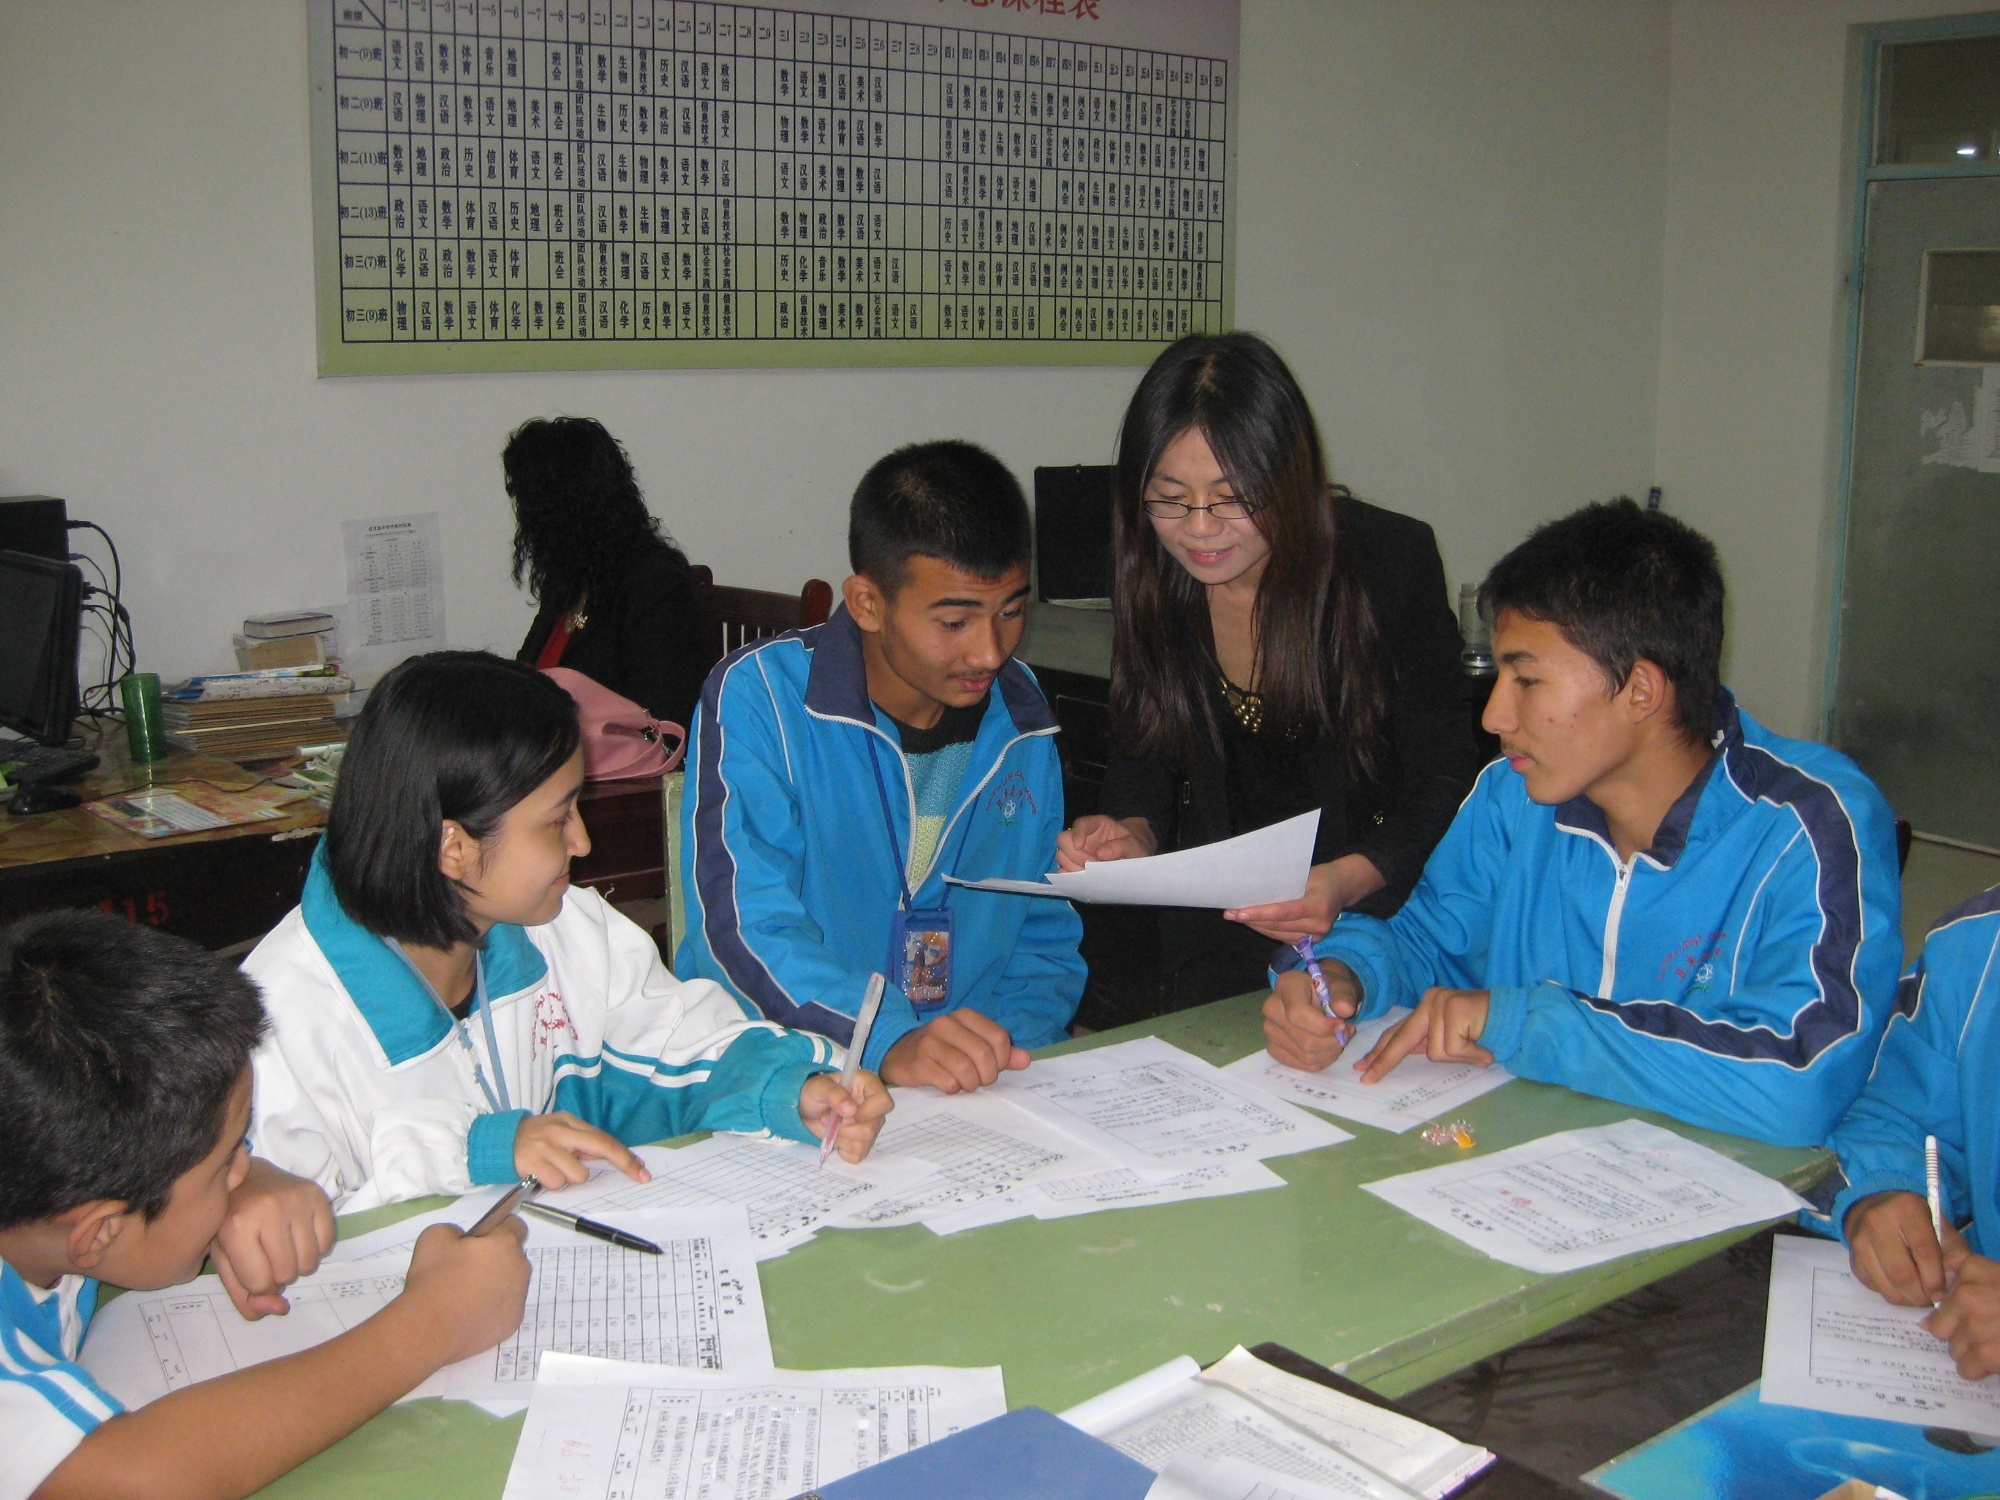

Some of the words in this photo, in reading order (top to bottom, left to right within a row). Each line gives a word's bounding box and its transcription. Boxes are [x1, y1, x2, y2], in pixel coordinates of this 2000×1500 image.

[338, 44, 382, 61] 初一(9)班
[392, 40, 402, 70] 语文
[414, 41, 425, 72] 汉语
[439, 43, 449, 74] 数学
[461, 44, 472, 75] 体育
[484, 46, 494, 76] 音乐
[507, 48, 517, 77] 地理
[551, 51, 562, 81] 班会
[597, 54, 607, 84] 数学
[618, 55, 628, 84] 生物
[660, 58, 669, 88] 历史
[680, 60, 690, 88] 汉语
[700, 62, 710, 90] 语文
[720, 63, 730, 92] 政治
[780, 69, 789, 96] 数学
[799, 71, 808, 98] 语文
[818, 72, 827, 99] 地理
[838, 74, 846, 101] 汉语
[339, 94, 383, 111] 初二(9)班
[393, 91, 403, 122] 汉语
[415, 93, 426, 123] 物理
[439, 94, 450, 124] 汉语
[463, 95, 473, 126] 数学
[485, 97, 495, 126] 语文
[507, 98, 517, 128] 地理
[531, 99, 540, 130] 美术
[553, 101, 564, 130] 班会
[597, 103, 606, 132] 生物
[618, 103, 628, 133] 历史
[639, 106, 648, 135] 数学
[659, 106, 669, 135] 政治
[682, 107, 692, 136] 汉语
[721, 110, 730, 138] 语文
[780, 115, 789, 143] 物理
[800, 116, 809, 144] 数学
[817, 118, 826, 145] 语文
[837, 118, 846, 146] 体育
[339, 149, 386, 166] 初二(11)班
[393, 144, 404, 175] 数学
[416, 146, 427, 177] 地理
[440, 147, 451, 177] 政治
[464, 147, 474, 178] 历史
[486, 149, 497, 179] 信息
[509, 149, 519, 180] 体育
[530, 150, 541, 180] 语文
[553, 151, 564, 181] 班会
[597, 153, 607, 182] 汉语
[618, 153, 628, 183] 生物
[639, 155, 649, 184] 物理
[659, 156, 669, 185] 数学
[680, 158, 690, 186] 语文
[700, 158, 710, 187] 数学
[721, 159, 730, 187] 汉语
[780, 162, 789, 189] 语文
[799, 164, 808, 191] 汉语
[819, 164, 827, 192] 美术
[836, 166, 845, 193] 物理
[341, 204, 387, 221] 初二(13)班
[394, 198, 405, 229] 政治
[417, 199, 428, 229] 语文
[441, 200, 452, 230] 数学
[465, 200, 476, 231] 体育
[488, 201, 499, 231] 汉语
[509, 201, 520, 231] 历史
[530, 202, 541, 232] 地理
[553, 203, 564, 233] 班会
[597, 205, 608, 234] 汉语
[618, 205, 628, 234] 数学
[639, 205, 649, 234] 生物
[660, 206, 670, 235] 物理
[680, 207, 691, 235] 语文
[700, 207, 710, 235] 汉语
[780, 211, 789, 239] 数学
[799, 212, 808, 239] 物理
[818, 213, 827, 240] 政治
[837, 213, 845, 241] 数学
[344, 254, 387, 270] 初三(7)班
[395, 247, 406, 278] 化学
[418, 247, 429, 278] 汉语
[442, 248, 453, 278] 政治
[466, 249, 476, 279] 数学
[487, 249, 498, 279] 语文
[509, 249, 520, 279] 体育
[554, 250, 565, 279] 班会
[620, 251, 630, 280] 物理
[640, 251, 650, 280] 汉语
[661, 252, 670, 280] 语文
[682, 252, 692, 281] 数学
[780, 254, 789, 282] 历史
[799, 255, 808, 282] 化学
[818, 255, 827, 282] 音乐
[837, 256, 846, 283] 数学
[345, 307, 388, 323] 初三(9)班
[396, 300, 408, 331] 物理
[421, 301, 432, 331] 汉语
[443, 300, 454, 331] 数学
[467, 301, 477, 330] 语文
[489, 300, 500, 330] 体育
[511, 301, 521, 330] 化学
[533, 300, 544, 330] 数学
[555, 301, 565, 330] 班会
[599, 300, 609, 329] 汉语
[619, 300, 629, 329] 化学
[641, 301, 651, 330] 历史
[662, 301, 671, 330] 数学
[682, 302, 692, 330] 语文
[779, 301, 789, 329] 政治
[818, 303, 827, 330] 物理
[838, 303, 846, 330] 美术
